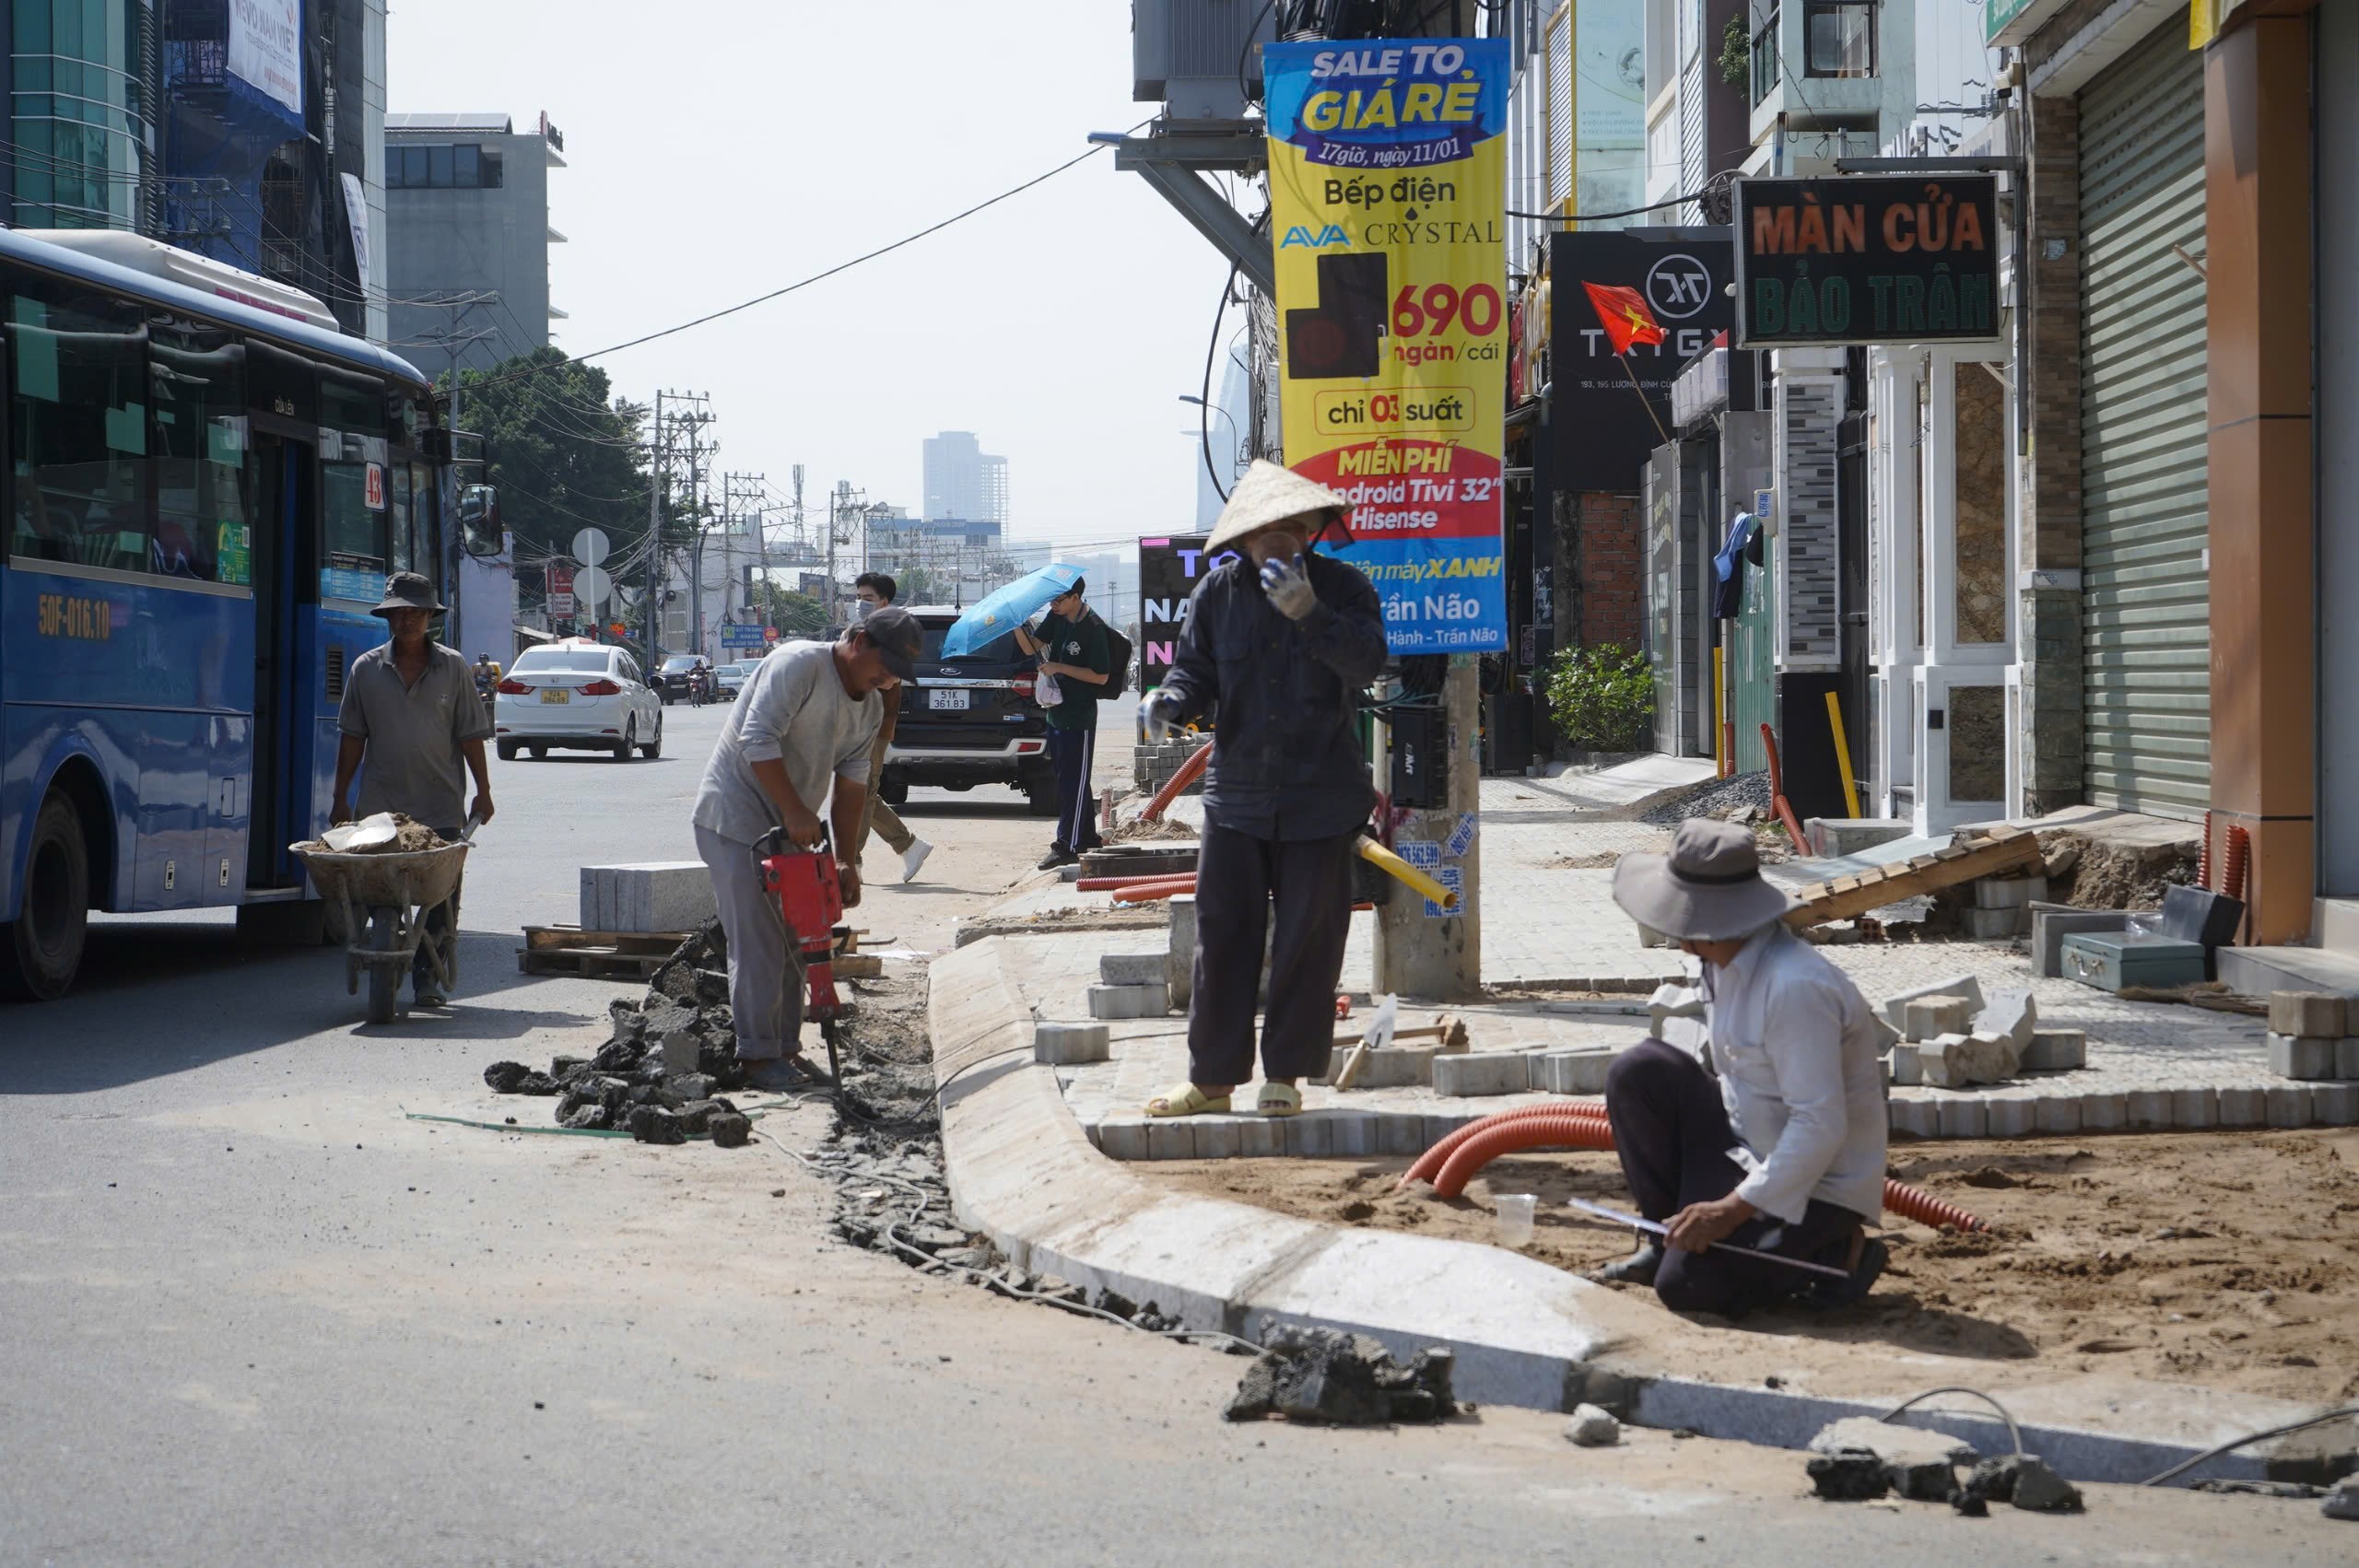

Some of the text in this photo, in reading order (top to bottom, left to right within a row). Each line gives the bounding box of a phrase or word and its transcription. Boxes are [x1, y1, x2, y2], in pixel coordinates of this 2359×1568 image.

[1310, 50, 1402, 78] SALE
[1302, 70, 1481, 131] GIÁ RẺ
[1373, 144, 1412, 168] ngày
[1413, 137, 1461, 162] 11/01
[1325, 175, 1455, 210] Bếp điện
[1753, 183, 1986, 255] MÀN CỬA
[1279, 221, 1503, 249] AVA CRYSTAL
[1392, 283, 1502, 338] 690
[1755, 260, 1851, 334] BẢO
[1867, 263, 1991, 333] TRÂN
[1328, 400, 1365, 424] chỉ
[1405, 395, 1463, 421] suất
[1337, 436, 1461, 476] MIỄN PHÍ
[367, 468, 381, 505] 43
[1410, 478, 1456, 503] Tivi
[1350, 507, 1438, 532] Hisense
[1385, 556, 1425, 584] máy
[1425, 556, 1503, 579] XANH
[39, 594, 111, 641] 50F-016.10
[1424, 593, 1481, 622] Não
[1387, 629, 1422, 647] Hành
[1435, 628, 1468, 645] Trần
[1471, 626, 1498, 644] Não
[934, 699, 965, 708] 361.83
[941, 691, 957, 699] 51K
